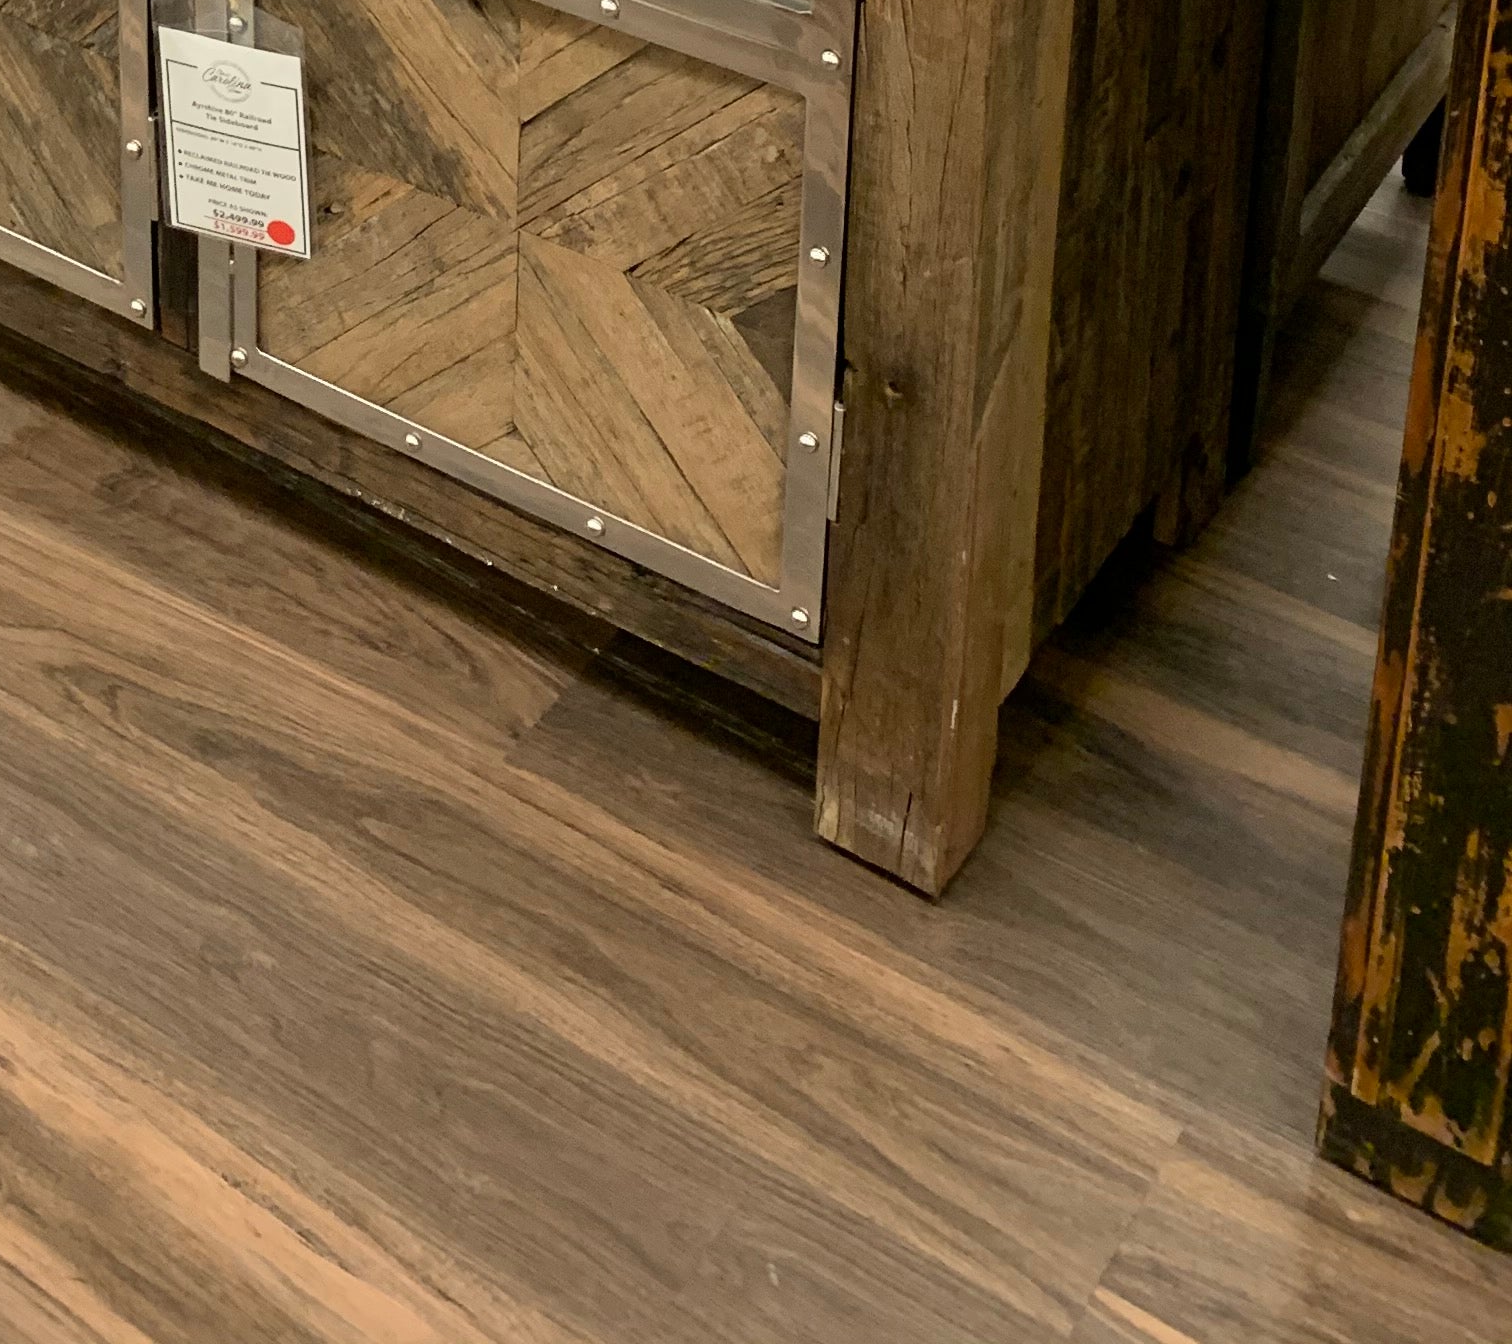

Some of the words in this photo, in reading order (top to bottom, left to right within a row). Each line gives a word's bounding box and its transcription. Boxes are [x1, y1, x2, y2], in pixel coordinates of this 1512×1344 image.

[202, 68, 251, 90] Carolina
[206, 113, 217, 121] Tie
[219, 116, 259, 131] Sideboard
[239, 112, 272, 125] Railroad
[273, 172, 297, 182] WOOD
[245, 189, 270, 200] TODAY
